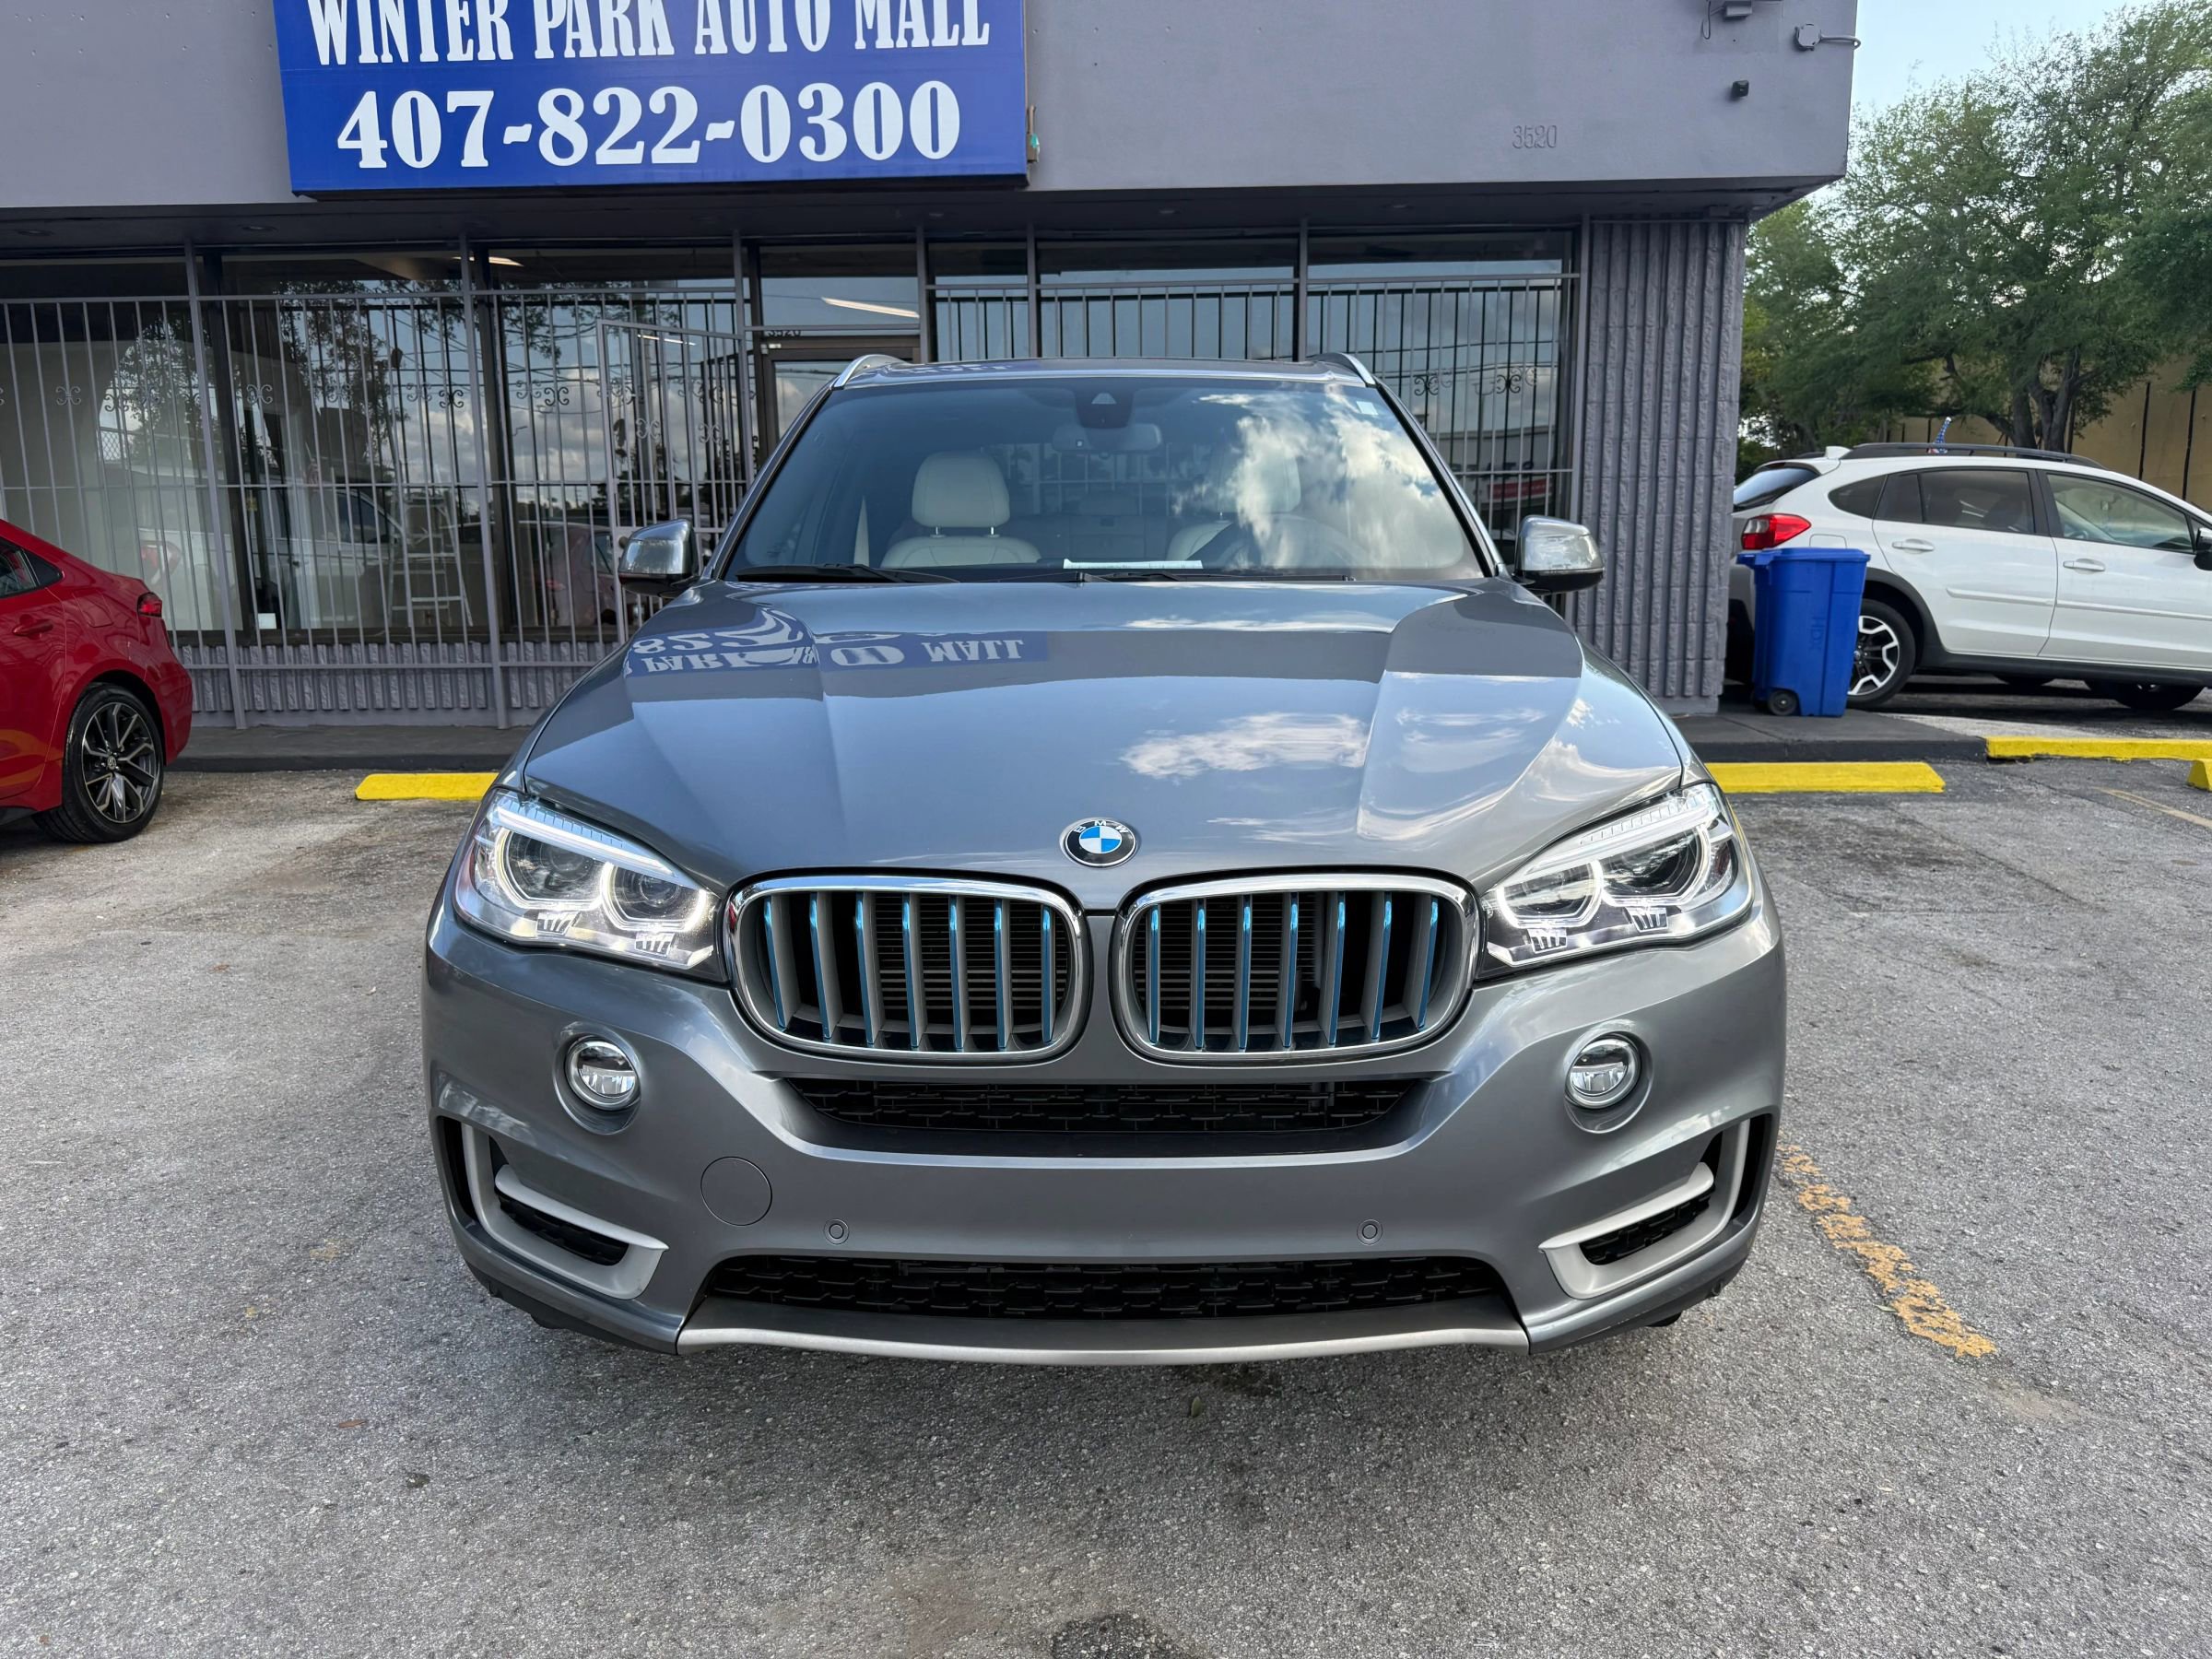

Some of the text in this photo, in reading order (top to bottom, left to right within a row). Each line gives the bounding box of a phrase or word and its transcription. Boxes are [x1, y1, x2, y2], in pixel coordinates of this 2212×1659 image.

[307, 0, 990, 65] WINTER PARK AUTO MALL
[337, 80, 960, 169] 407-822-0300
[1512, 124, 1558, 148] 3520
